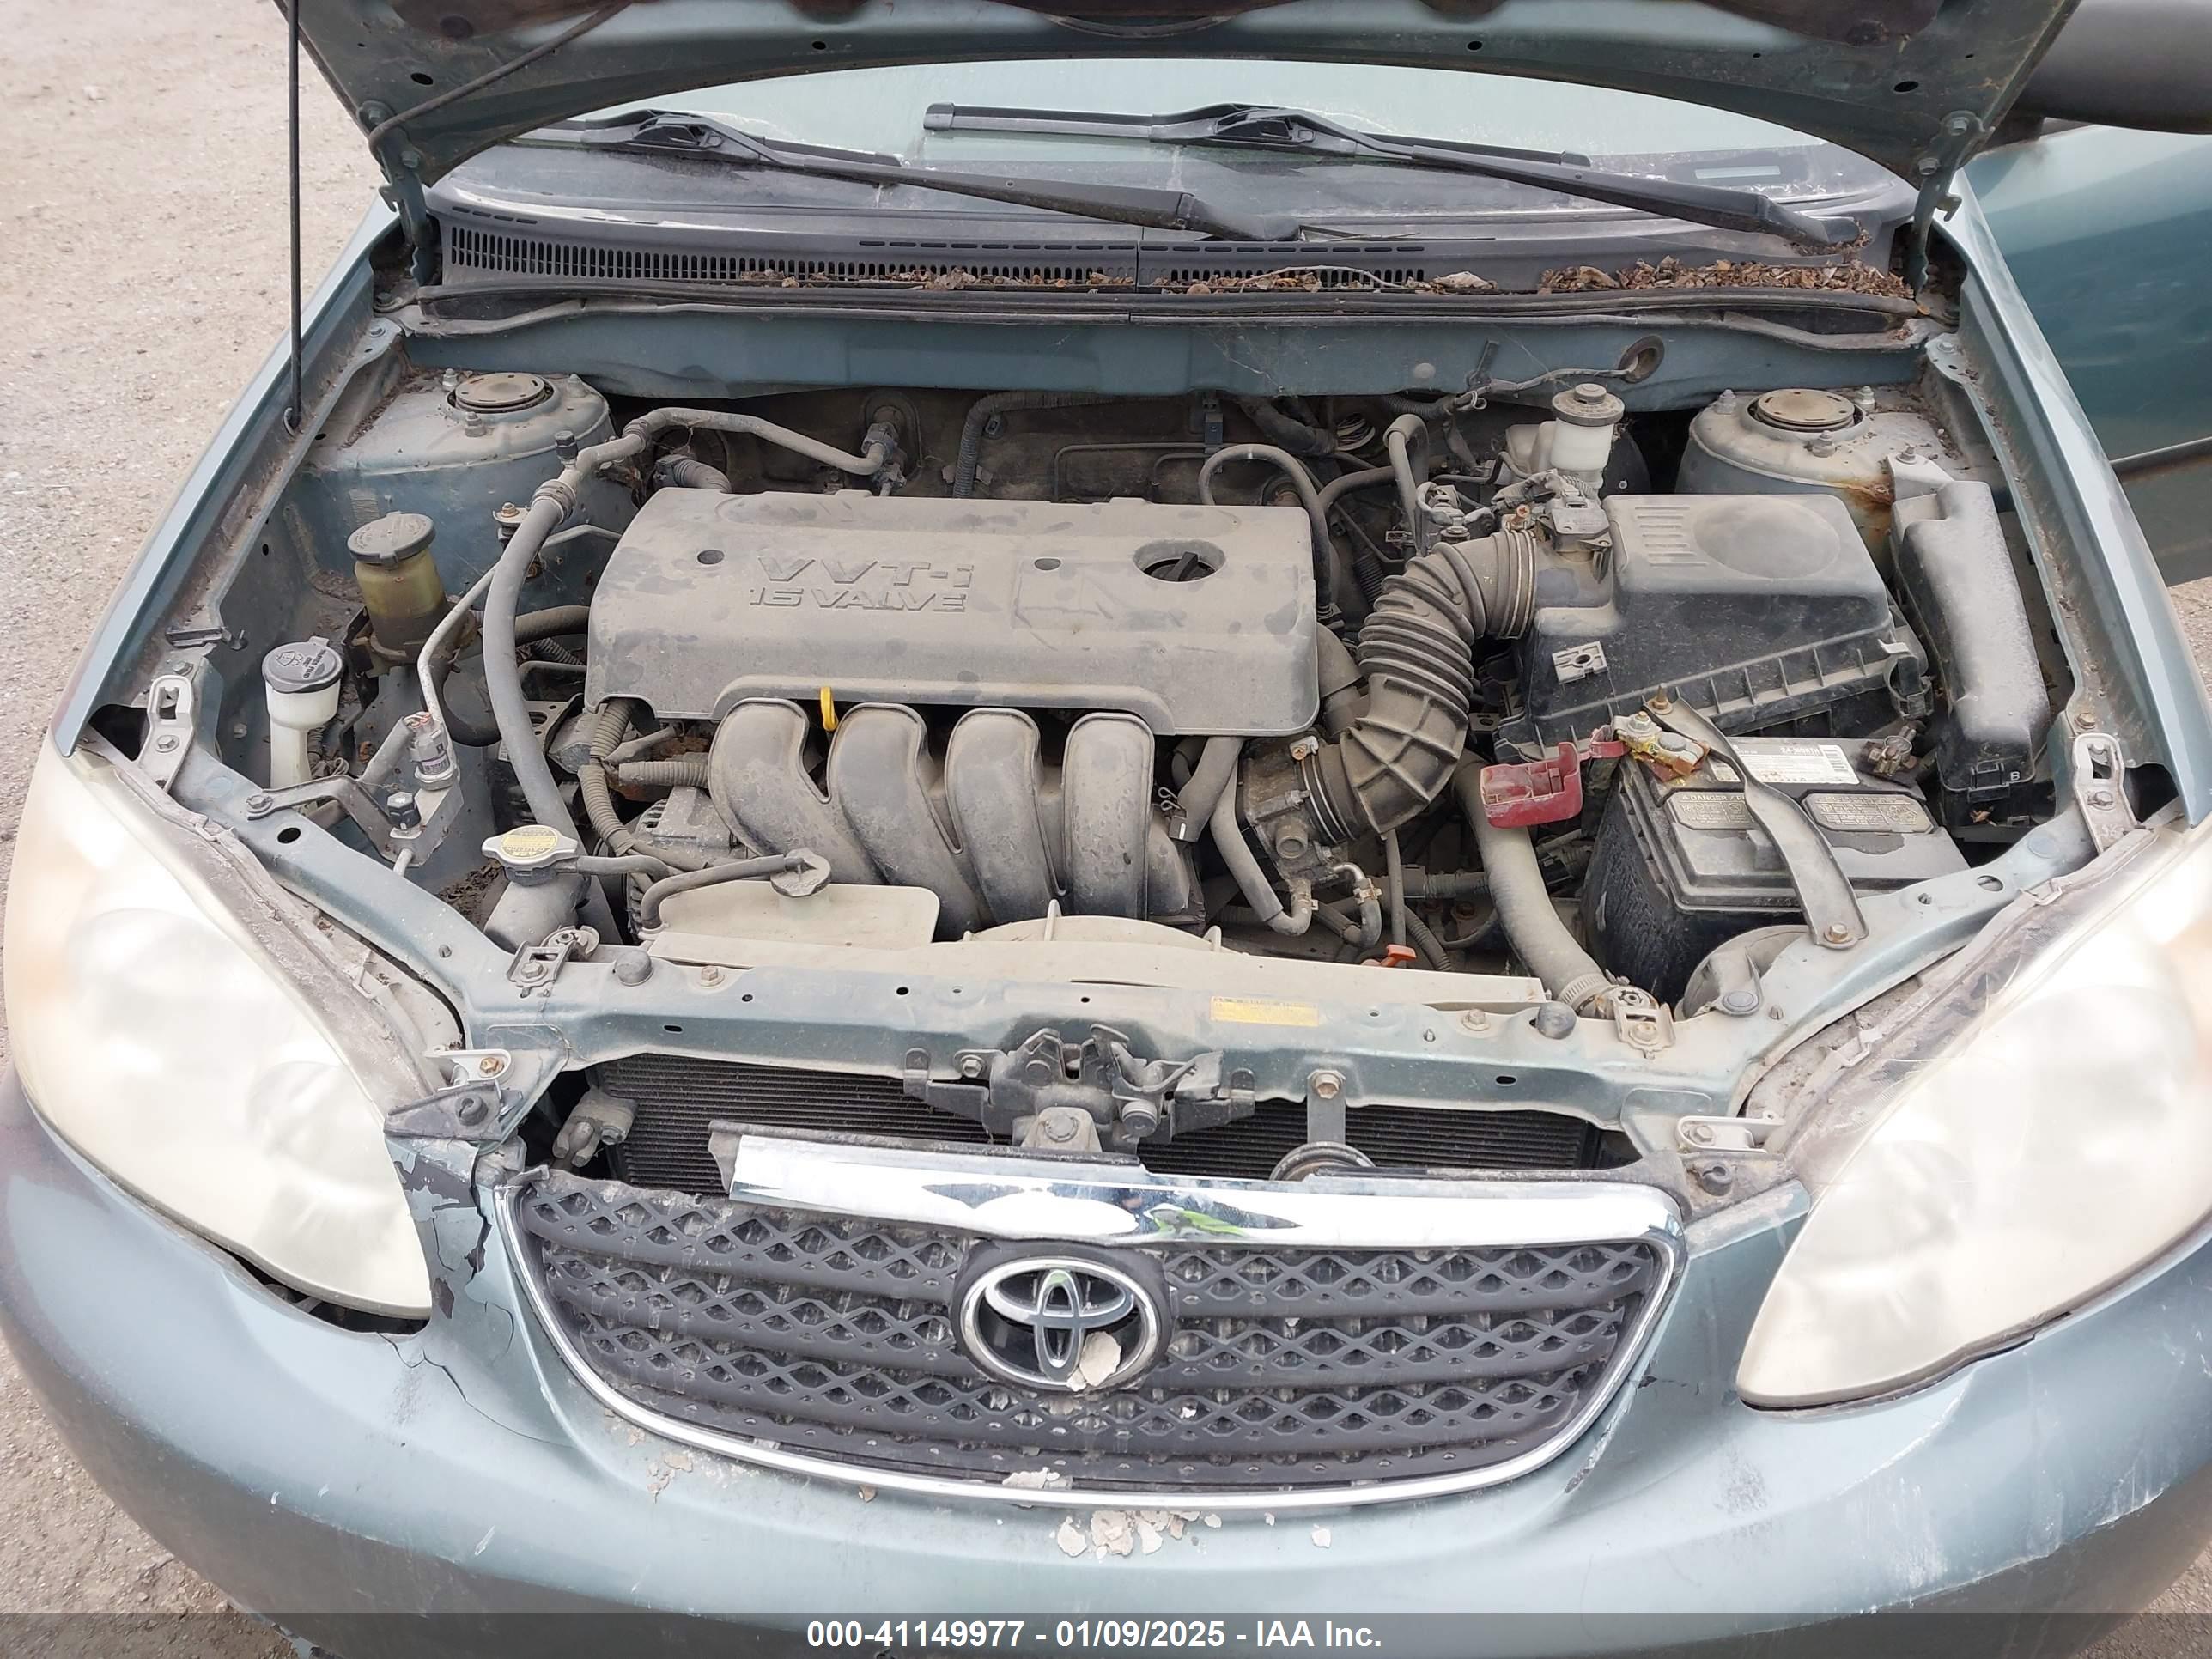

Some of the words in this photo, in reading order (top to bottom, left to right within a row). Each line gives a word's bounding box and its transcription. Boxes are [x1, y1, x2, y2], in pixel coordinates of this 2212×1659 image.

[757, 556, 975, 588] VVT-i
[749, 586, 805, 607] 16
[810, 588, 968, 613] VALVE
[2010, 771, 2021, 781] B
